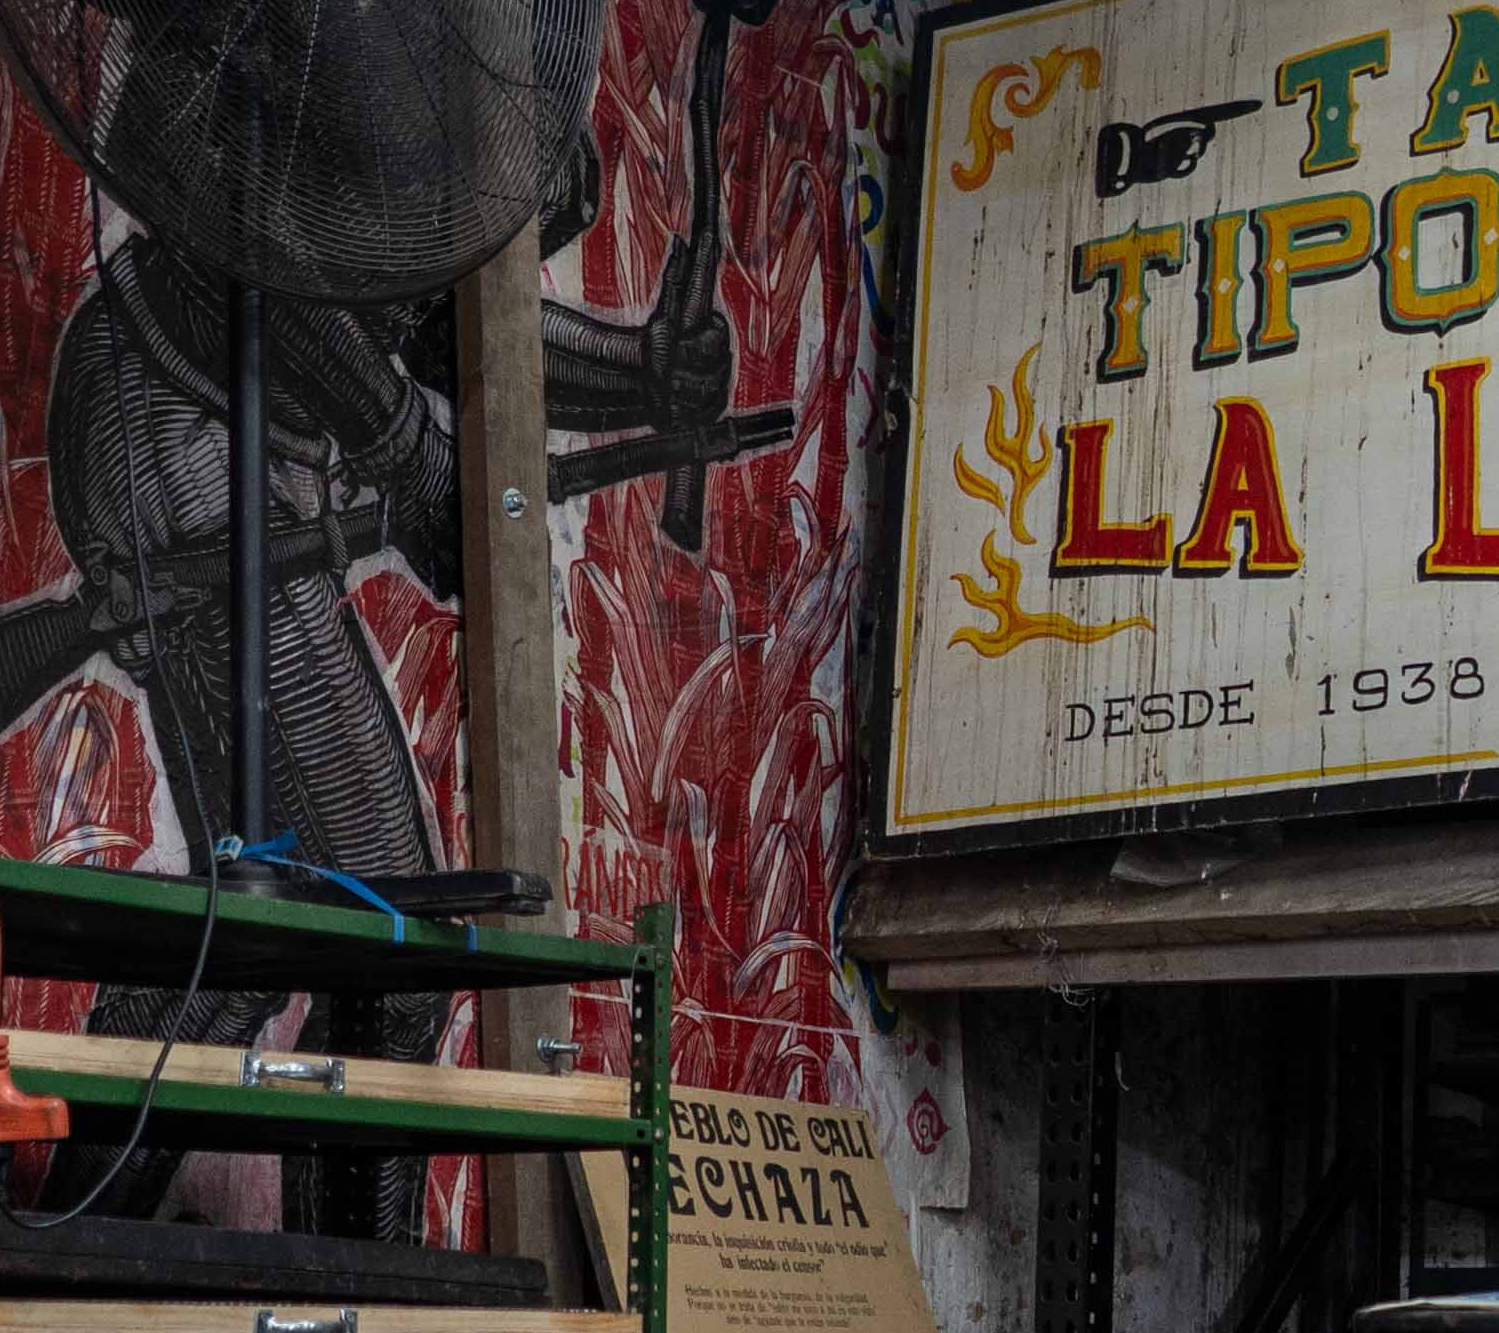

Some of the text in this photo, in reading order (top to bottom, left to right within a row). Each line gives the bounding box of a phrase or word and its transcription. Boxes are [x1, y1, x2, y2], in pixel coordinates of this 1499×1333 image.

[1048, 395, 1302, 582] LA
[1063, 655, 1487, 744] DESDE 1938
[668, 1100, 751, 1148] EBLO
[755, 1110, 802, 1153] DE
[667, 1153, 870, 1228] ECHAZA
